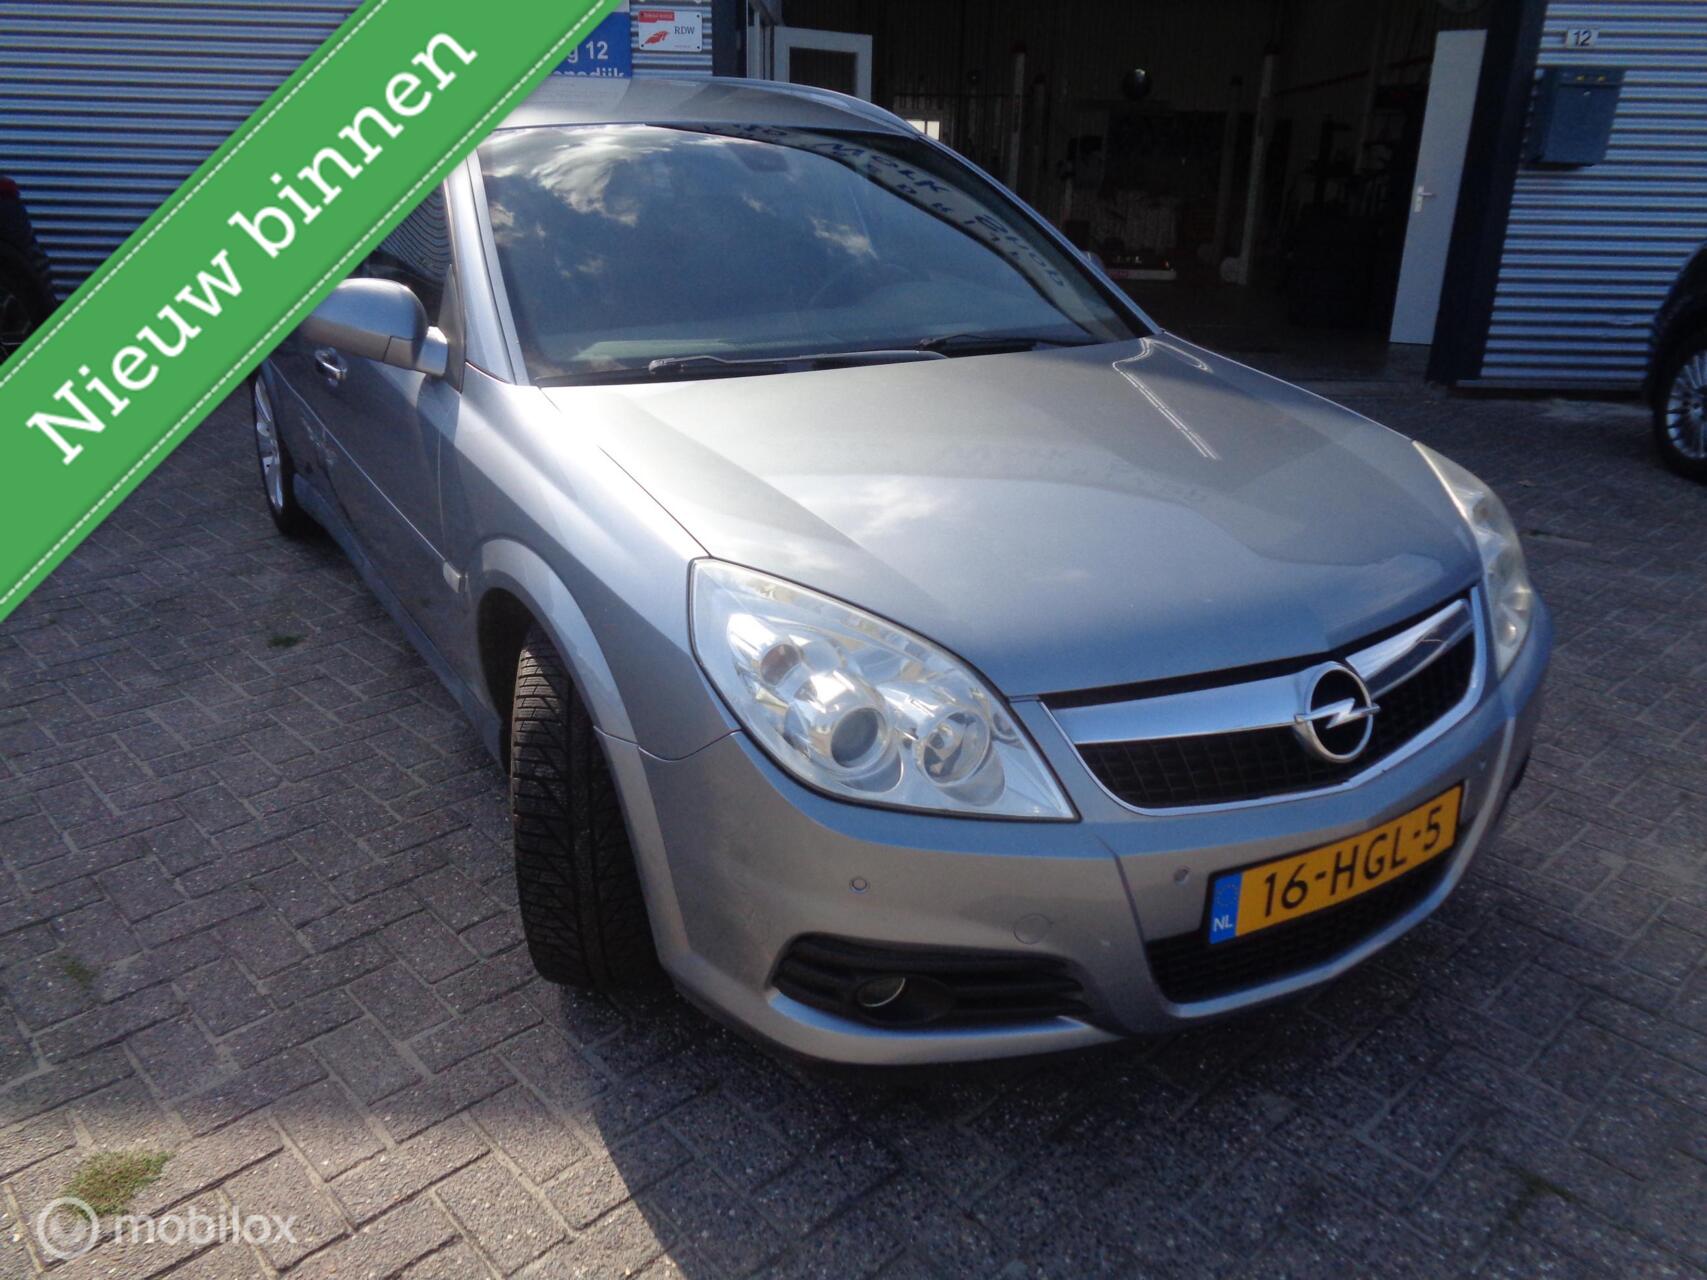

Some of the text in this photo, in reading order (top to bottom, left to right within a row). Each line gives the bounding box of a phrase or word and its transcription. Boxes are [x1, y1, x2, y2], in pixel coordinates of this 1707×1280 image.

[674, 26, 695, 35] RDW
[1573, 30, 1592, 46] 12
[585, 40, 609, 60] 12
[1264, 805, 1443, 917] 16-HGL-5
[1212, 914, 1233, 932] NL
